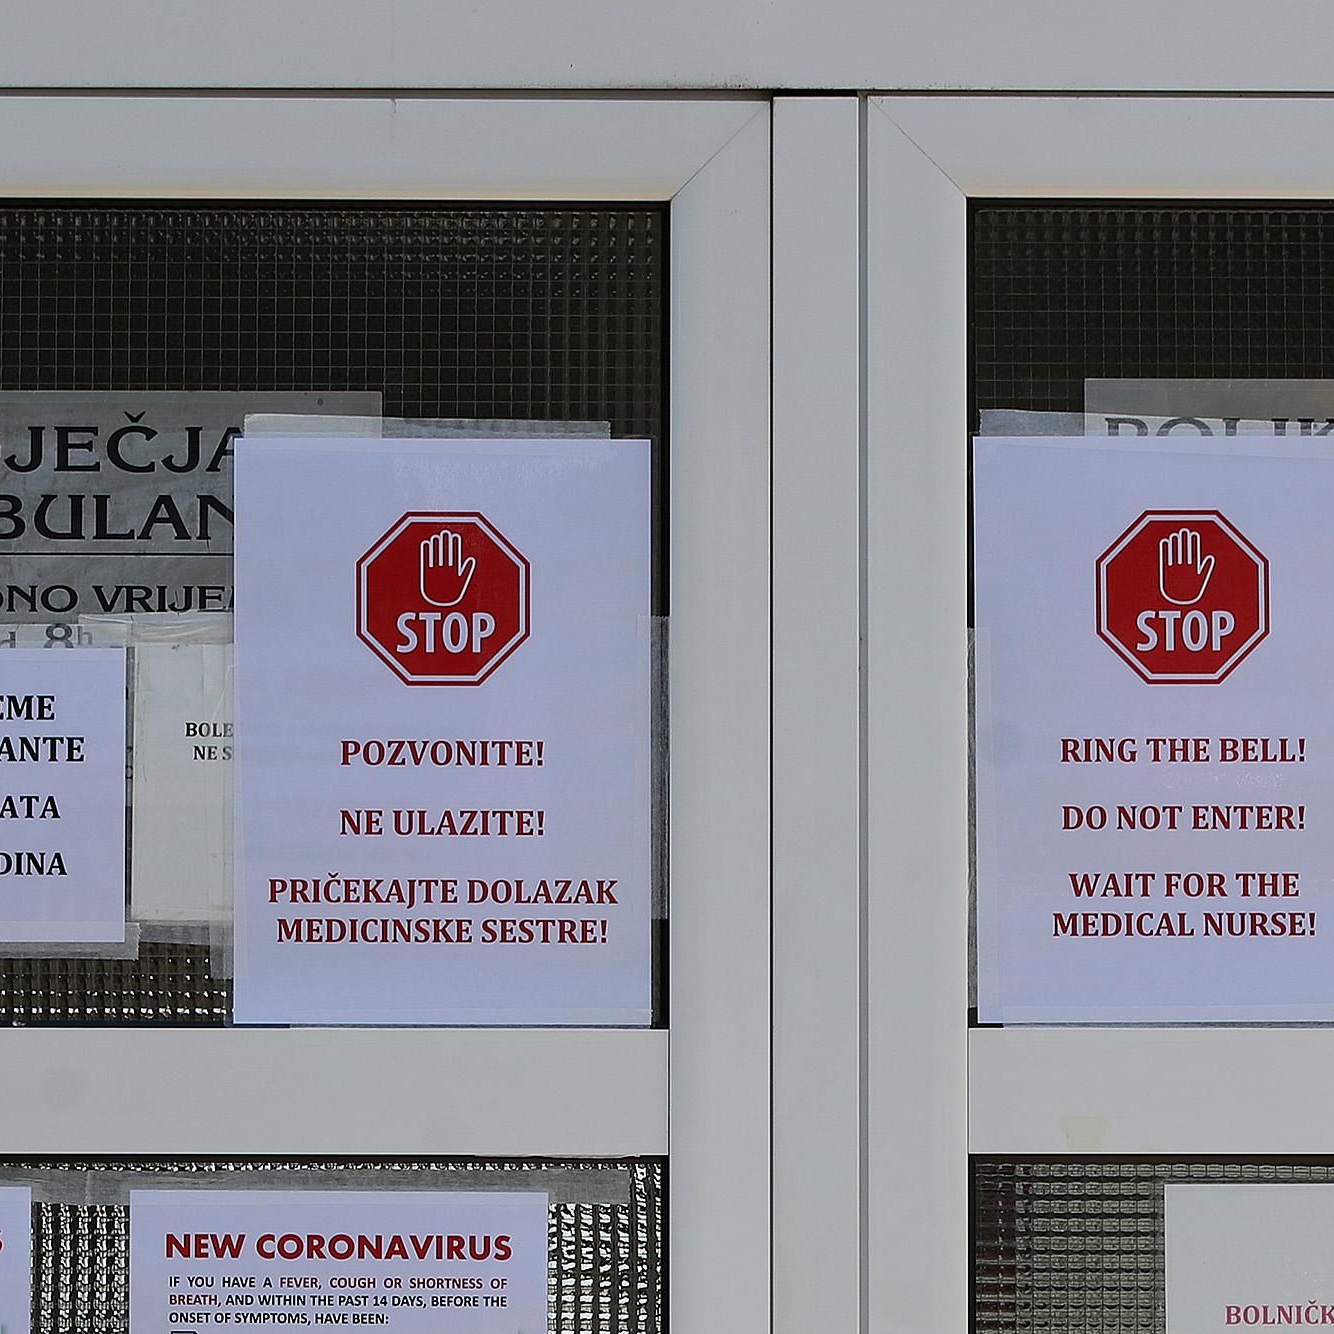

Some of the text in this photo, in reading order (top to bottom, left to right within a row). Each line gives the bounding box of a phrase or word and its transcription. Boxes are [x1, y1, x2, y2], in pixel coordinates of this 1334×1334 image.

[91, 584, 234, 614] VRIJE
[395, 610, 496, 656] STOP
[1136, 609, 1236, 653] STOP
[340, 740, 544, 767] POZVONITE!
[1060, 738, 1306, 763] RING THE BELL!
[339, 809, 545, 836] NE ULAZITE!
[1061, 805, 1305, 830] DO NOT ENTER!
[268, 872, 619, 910] PRIČEKAJTE DOLAZAK
[1068, 872, 1300, 898] WAIT FOR THE
[276, 918, 608, 944] MEDICINSKE SESTRE!
[1052, 912, 1316, 937] MEDICAL NURSE!
[165, 1233, 512, 1261] NEW CORONAVIRUS
[168, 1311, 389, 1327] ONSET OF SYMPTOMS, HAVE BEEN:
